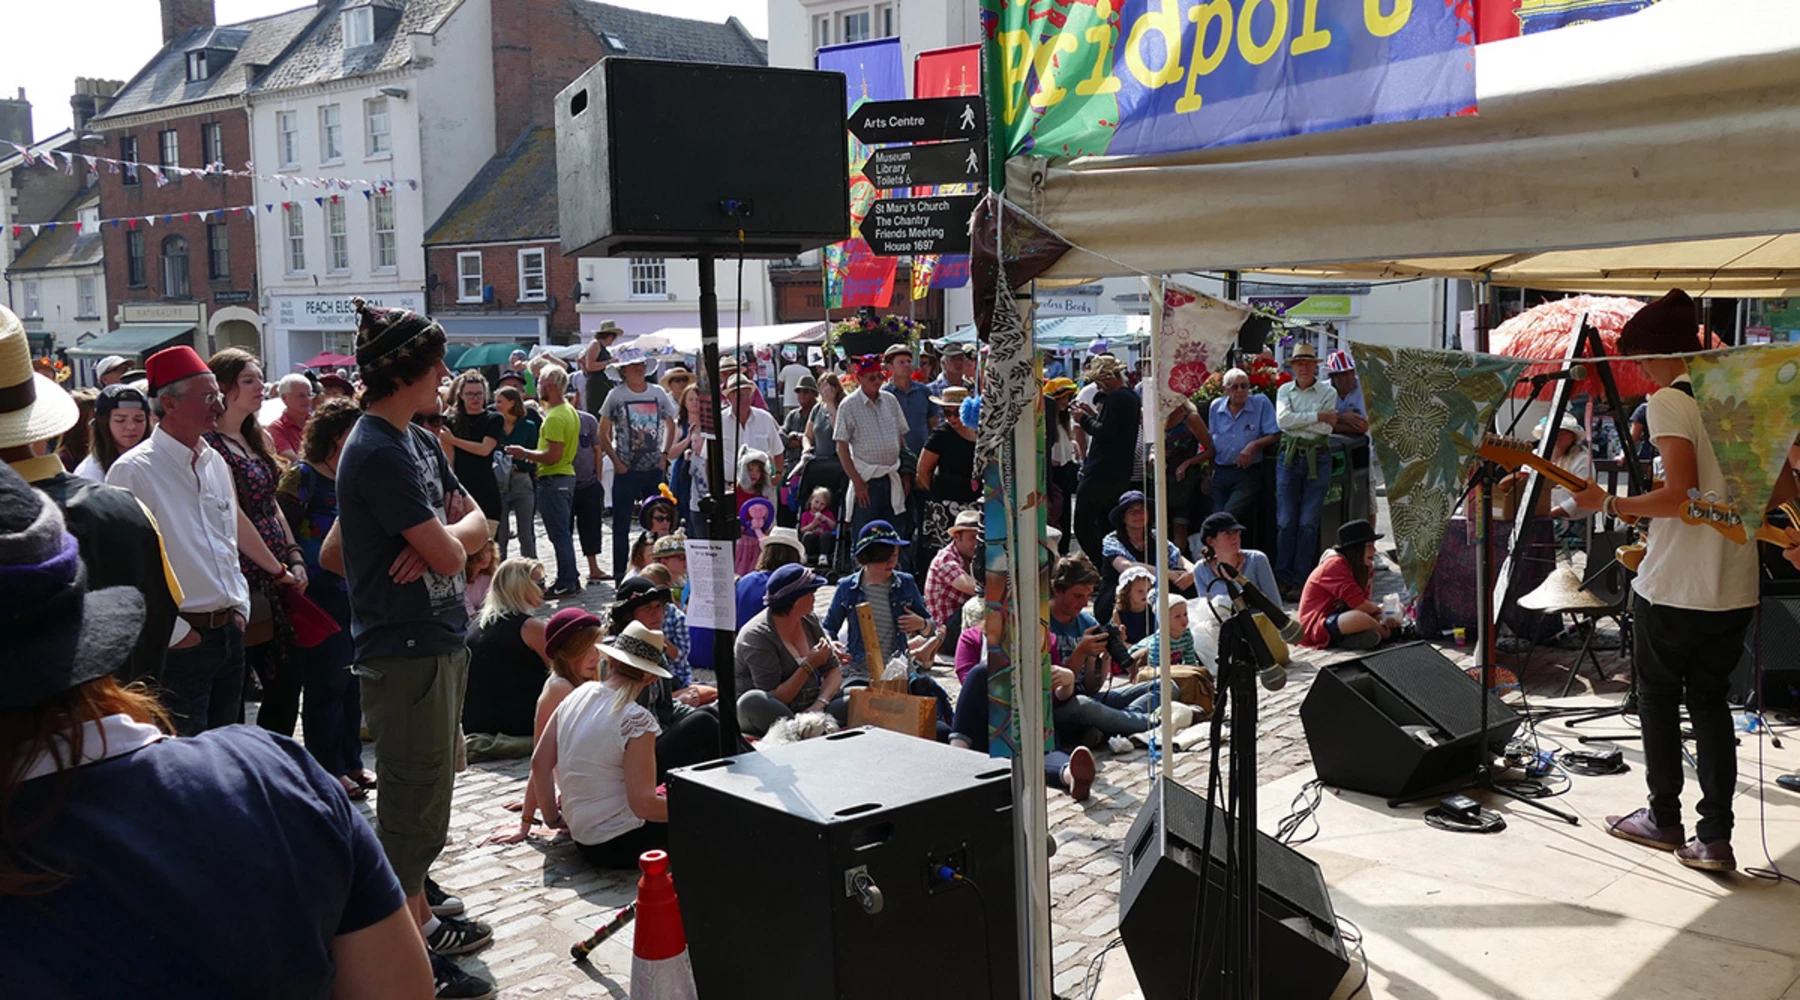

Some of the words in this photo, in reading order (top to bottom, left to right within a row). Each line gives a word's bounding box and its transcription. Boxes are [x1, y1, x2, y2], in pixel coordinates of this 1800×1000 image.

[863, 118, 887, 129] Arts
[888, 116, 925, 128] Centre
[875, 152, 911, 163] Museum
[875, 164, 907, 175] Library
[876, 175, 901, 186] Toilets
[875, 203, 885, 214] St
[886, 202, 916, 215] Mary's
[917, 200, 950, 212] Church
[876, 216, 892, 227] The
[893, 215, 930, 227] Chantry
[875, 228, 907, 239] Friends
[908, 227, 944, 239] Meeting
[884, 241, 912, 252] House
[914, 240, 934, 250] 1697
[306, 301, 333, 314] PEACH
[1065, 299, 1092, 314] Books
